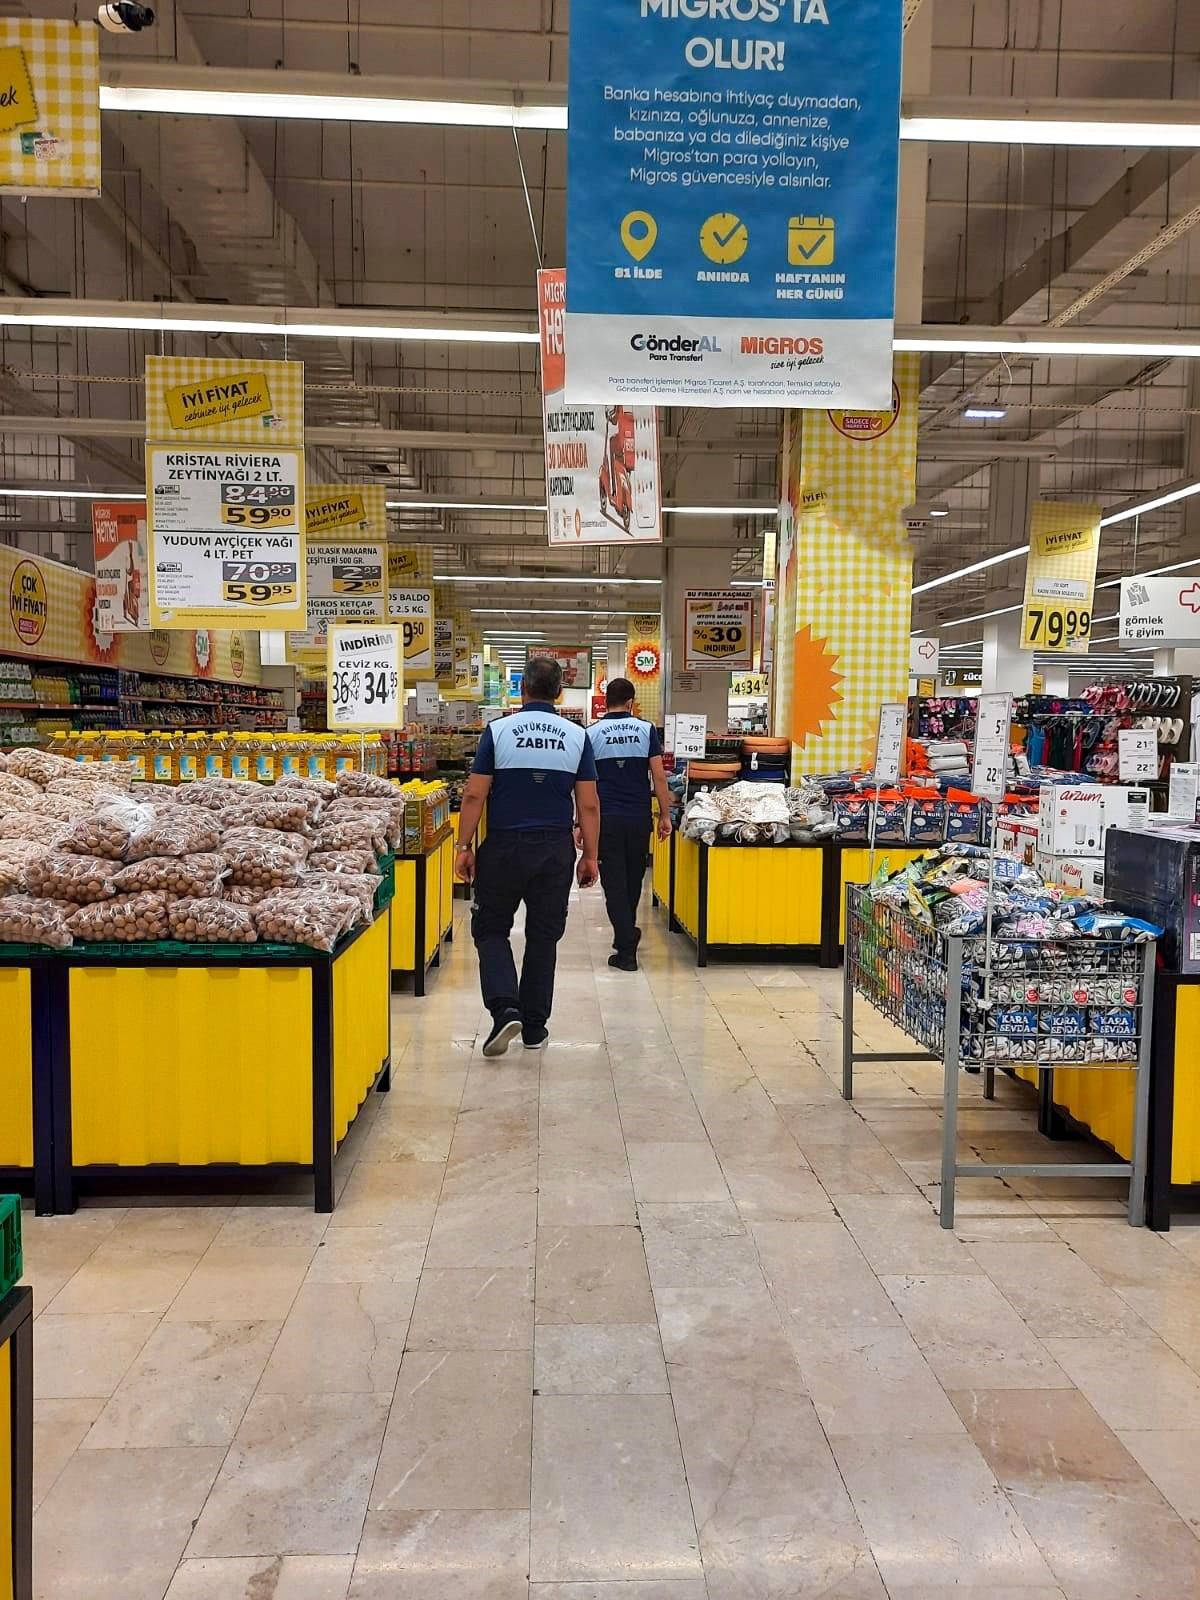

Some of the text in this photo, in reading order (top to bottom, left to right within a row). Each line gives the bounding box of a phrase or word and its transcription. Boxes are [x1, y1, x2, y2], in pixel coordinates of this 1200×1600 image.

[685, 37, 785, 71] OLUR!
[604, 86, 650, 100] Banka
[654, 88, 722, 103] hesabına
[777, 92, 862, 111] duymadan,
[629, 107, 831, 130] kızınıza, oğlunuza, annenize,
[614, 127, 849, 151] babanıza ya da dilediğiniz kişiye
[644, 148, 820, 170] Migros'tan para yollayın,
[630, 167, 832, 188] Migros güvencesiyle alsınlar.
[614, 266, 663, 280] 81 İLDE
[697, 271, 750, 284] ANINDA
[775, 272, 846, 285] HAFTANIN
[776, 287, 844, 300] HER GÜNÜ
[630, 333, 722, 353] GönderAL
[649, 353, 704, 363] Para Transferi
[770, 356, 825, 371] size iyi gelecek
[181, 381, 249, 409] İYİ FİYAT
[232, 392, 262, 414] gelecek
[166, 452, 281, 468] KRİSTAL RİVİERA
[168, 467, 283, 482] ZEYTİNYAĞI 2 LT.
[163, 535, 293, 549] YUDUM AYÇİÇEK YAĞI
[203, 549, 254, 560] 4 LT. PET
[342, 547, 378, 555] MAKARNA
[339, 556, 352, 564] 500
[21, 576, 38, 593] ÇOK
[400, 592, 430, 602] BALDO
[23, 595, 46, 617] FİYAT!
[340, 600, 373, 609] KETÇAP
[396, 605, 410, 613] 2.5
[340, 608, 361, 616] 1000
[1125, 615, 1163, 627] gömlek
[1125, 627, 1164, 638] iç giyim
[340, 633, 393, 652] İNDİRİM
[338, 659, 392, 669] CEVİZ KG.
[637, 656, 654, 667] 5M
[511, 721, 567, 740] BÜYÜKŞEHİR
[602, 722, 640, 736] BÜYÜKŞEHİR
[516, 737, 566, 751] ZABITA
[605, 735, 641, 745] ZABITA
[1060, 790, 1103, 803] arzum
[1062, 864, 1083, 879] arzum
[1001, 1014, 1029, 1025] KARA
[1052, 1016, 1079, 1026] KARA
[999, 1024, 1031, 1034] SEVDA
[1100, 1024, 1131, 1035] SEVDA
